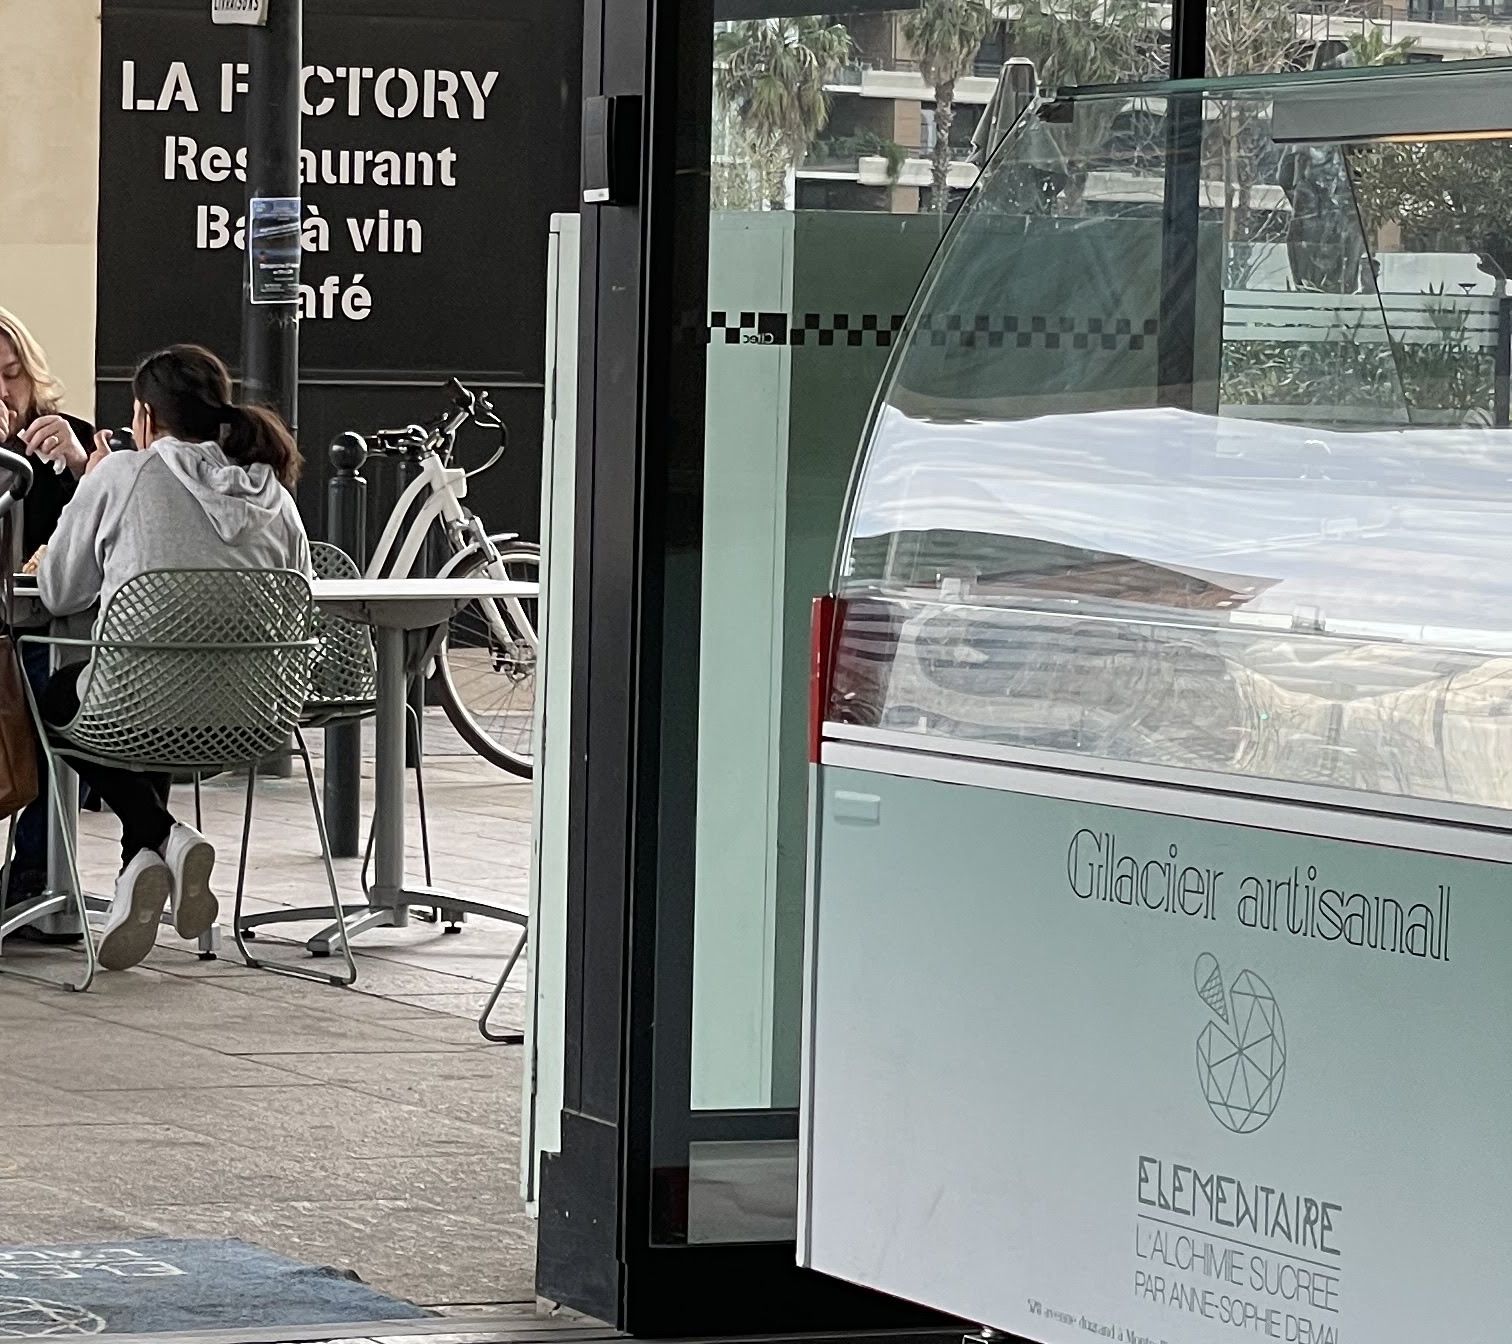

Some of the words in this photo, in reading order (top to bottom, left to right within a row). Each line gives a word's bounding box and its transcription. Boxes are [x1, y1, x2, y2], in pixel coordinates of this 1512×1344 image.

[121, 60, 199, 112] LA
[221, 62, 499, 120] FCTORY
[164, 135, 457, 187] Reaurant
[300, 204, 329, 252] à
[347, 209, 423, 253] vin
[299, 274, 372, 320] afé
[1067, 828, 1224, 921] Glacier
[1236, 865, 1451, 962] artisanal
[1138, 1155, 1342, 1256] ELEMENTAIRE
[1136, 1222, 1244, 1287] L'ALCHIMIE
[1135, 1270, 1165, 1304] PAR
[1169, 1281, 1281, 1338] ANNE-SOPHIE
